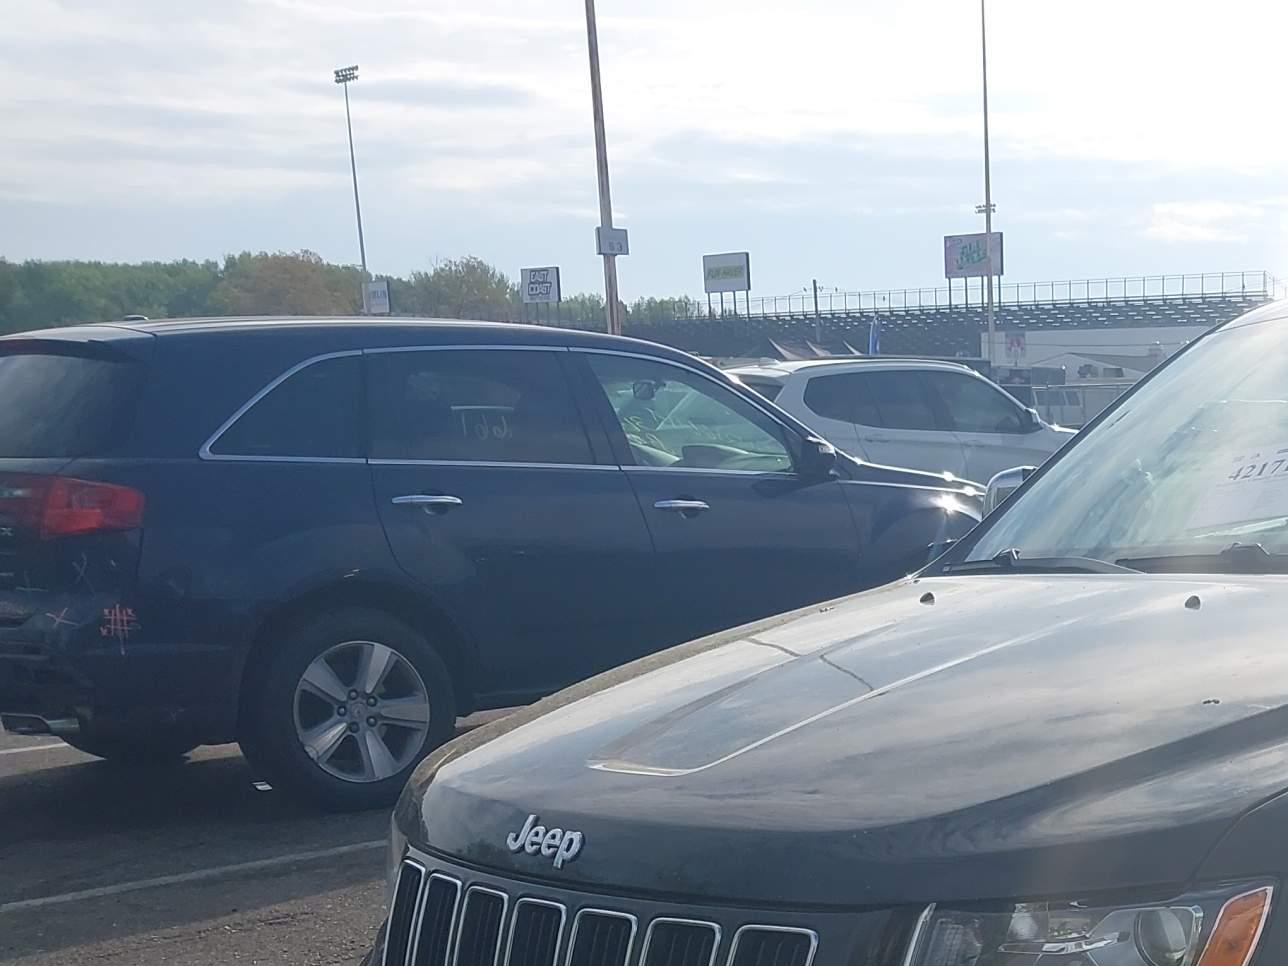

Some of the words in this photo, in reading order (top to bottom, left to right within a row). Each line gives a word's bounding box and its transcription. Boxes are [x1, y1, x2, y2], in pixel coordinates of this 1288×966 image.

[530, 270, 548, 282] EAST
[528, 282, 552, 295] COAST
[506, 814, 582, 869] Jeep
